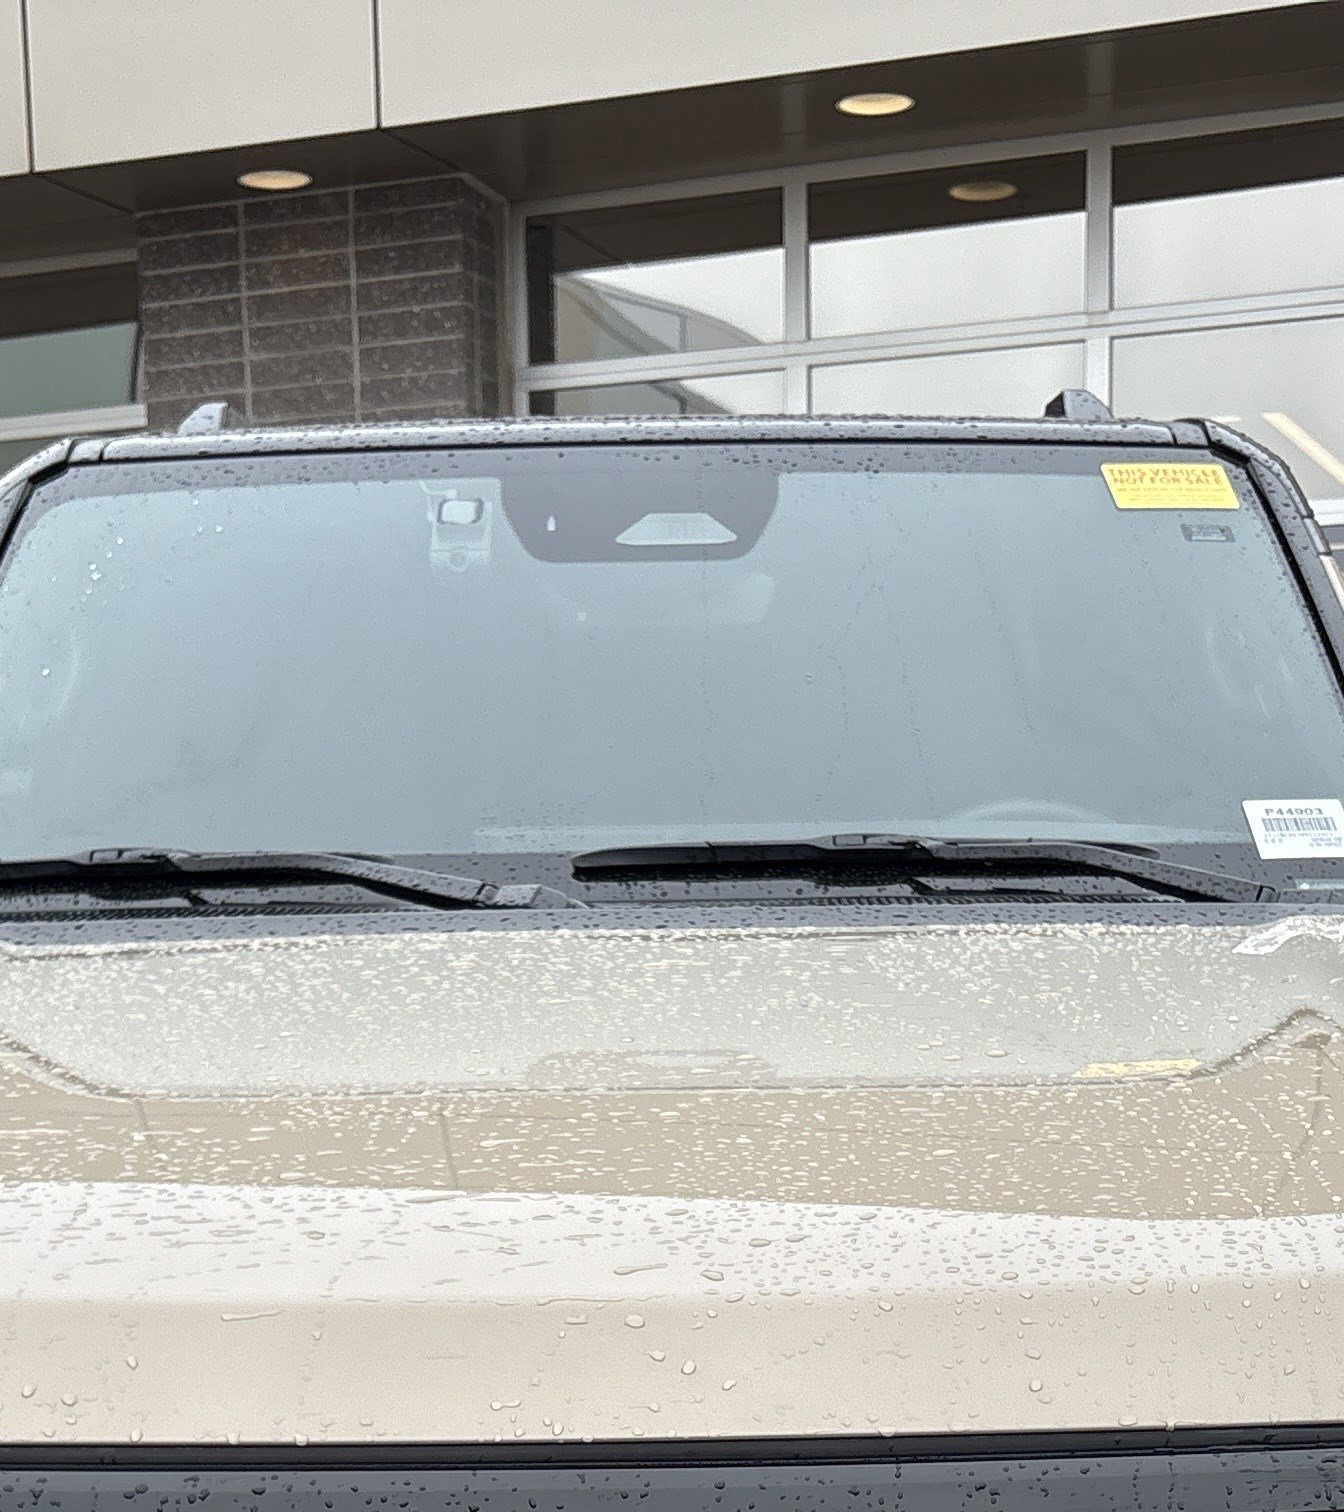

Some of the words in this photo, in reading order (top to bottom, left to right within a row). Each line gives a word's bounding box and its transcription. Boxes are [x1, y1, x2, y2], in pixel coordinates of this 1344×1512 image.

[1109, 468, 1146, 478] THIS
[1149, 468, 1219, 478] VEHICLE
[1113, 477, 1144, 485] NOT
[1149, 477, 1180, 485] FOR
[1185, 477, 1223, 485] SALE
[1265, 808, 1324, 816] P44903
